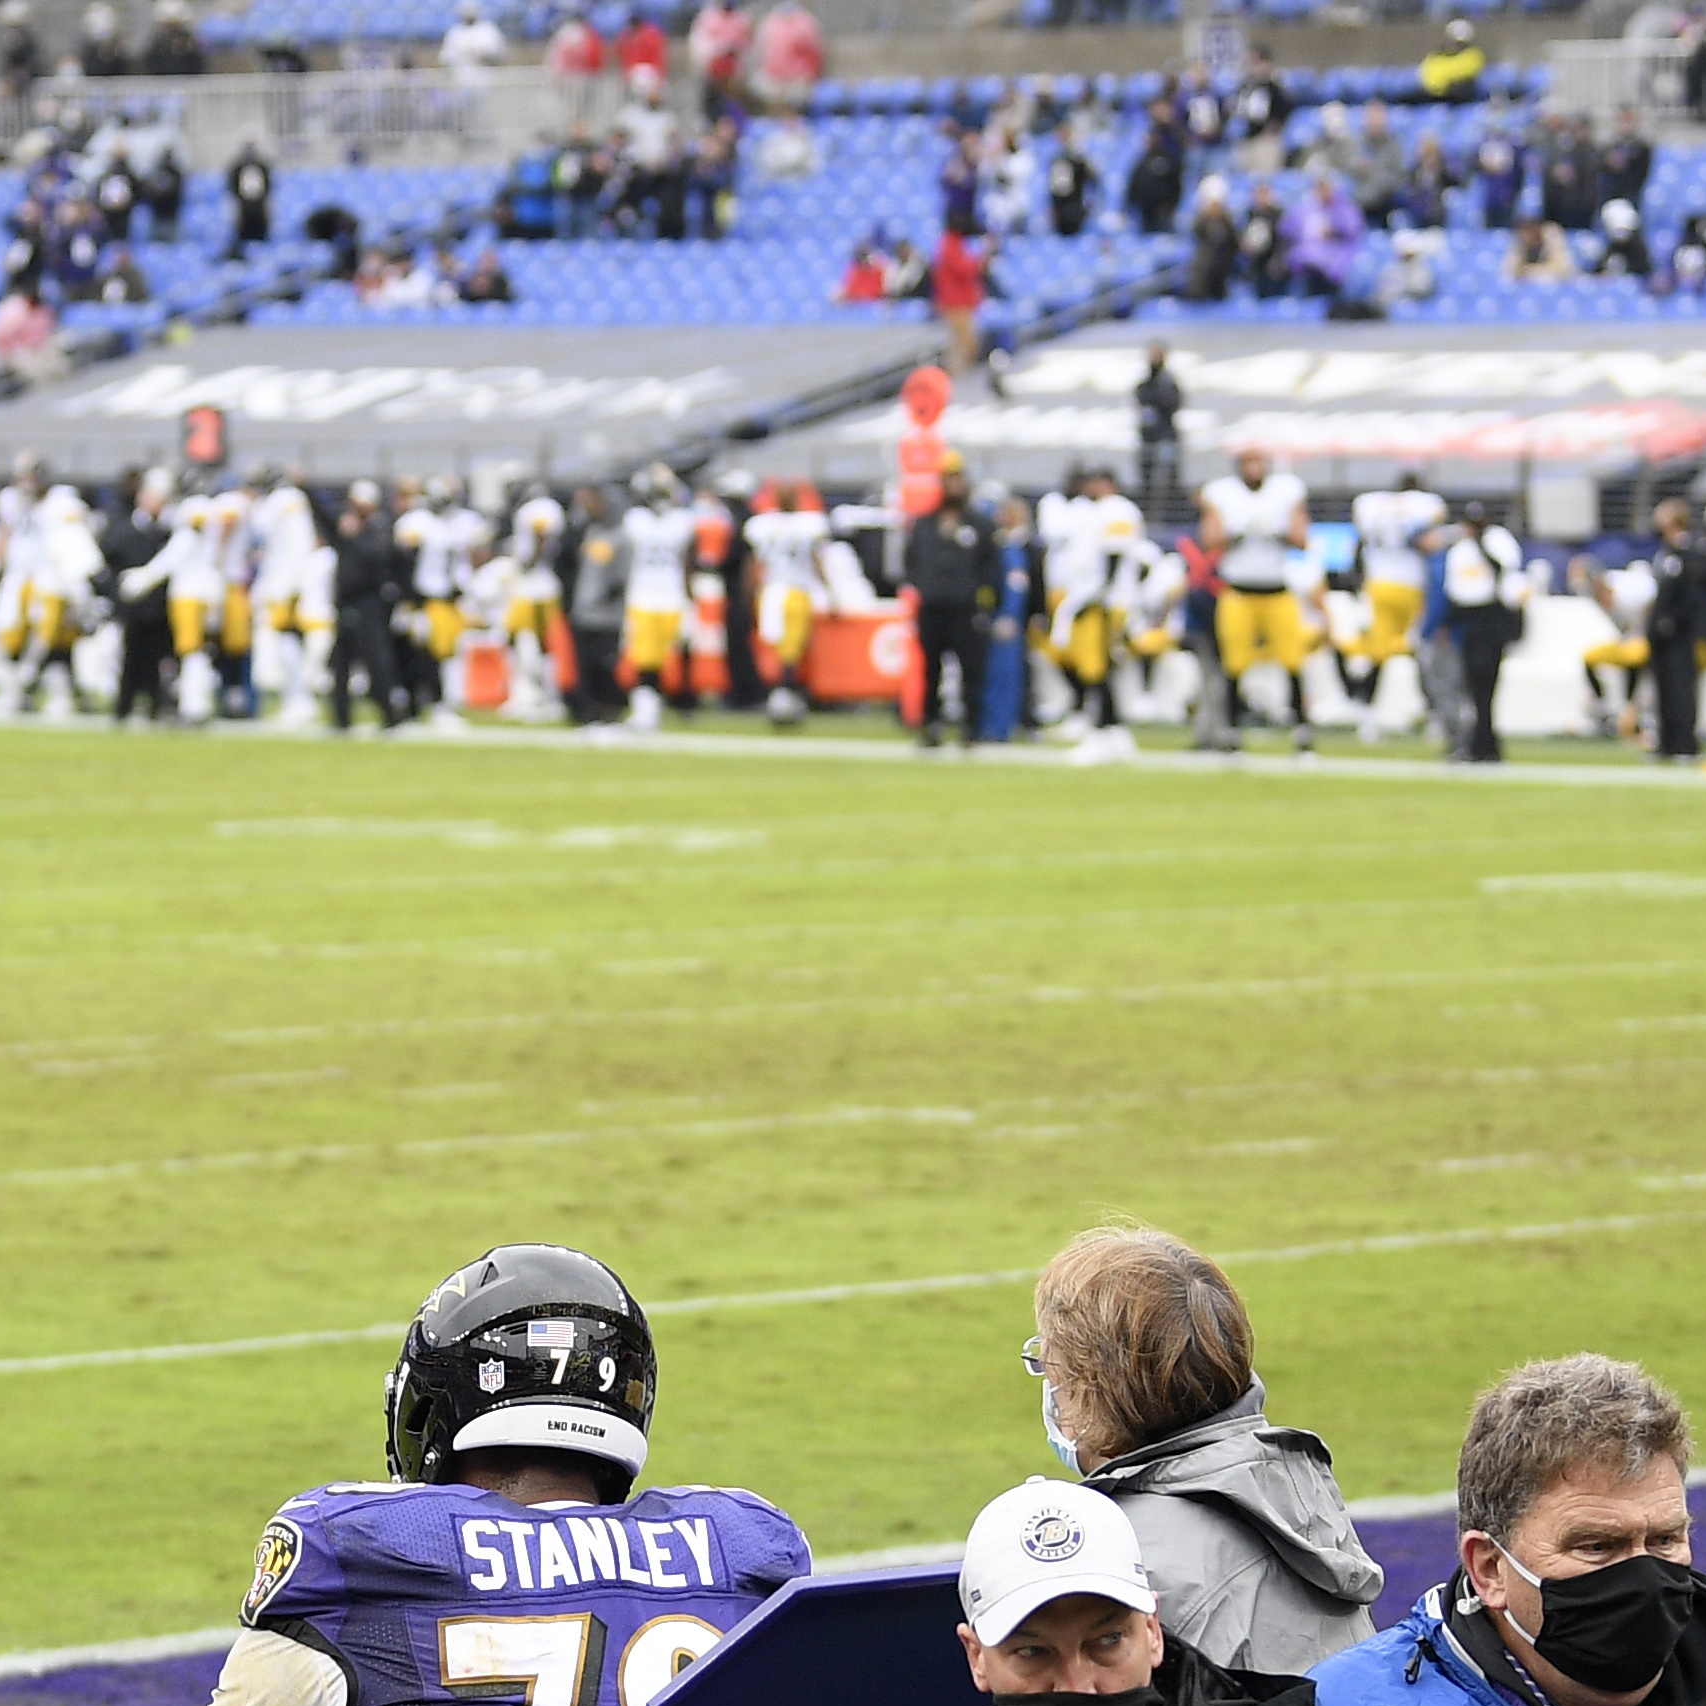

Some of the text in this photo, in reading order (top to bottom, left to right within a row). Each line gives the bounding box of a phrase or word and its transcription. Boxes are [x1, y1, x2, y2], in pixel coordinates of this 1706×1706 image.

[482, 1373, 502, 1388] NFL
[547, 1420, 607, 1438] END RACISM
[460, 1516, 715, 1591] STANLEY
